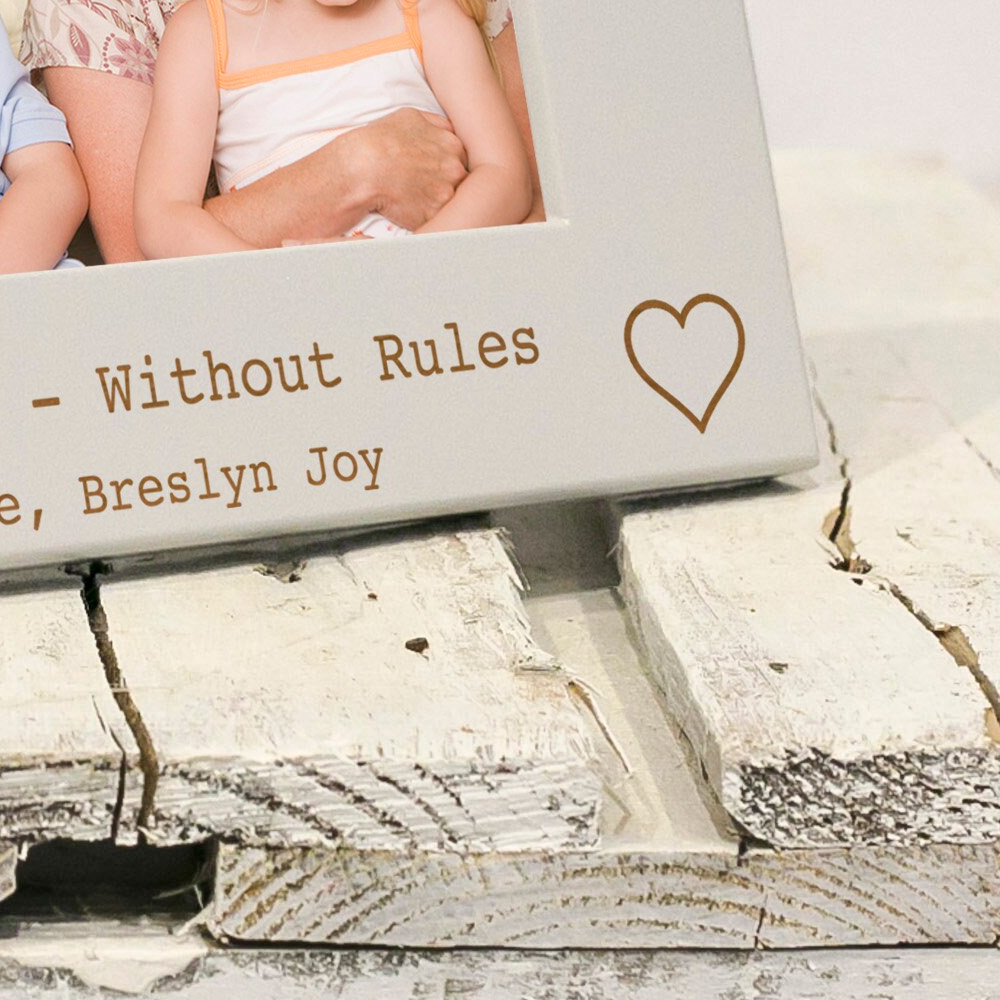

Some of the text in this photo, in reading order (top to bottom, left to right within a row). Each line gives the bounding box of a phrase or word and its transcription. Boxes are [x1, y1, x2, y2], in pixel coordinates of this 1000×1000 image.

[95, 343, 342, 414] Without
[372, 322, 540, 381] Rules
[77, 457, 278, 515] Breslyn
[306, 446, 384, 491] Joy
